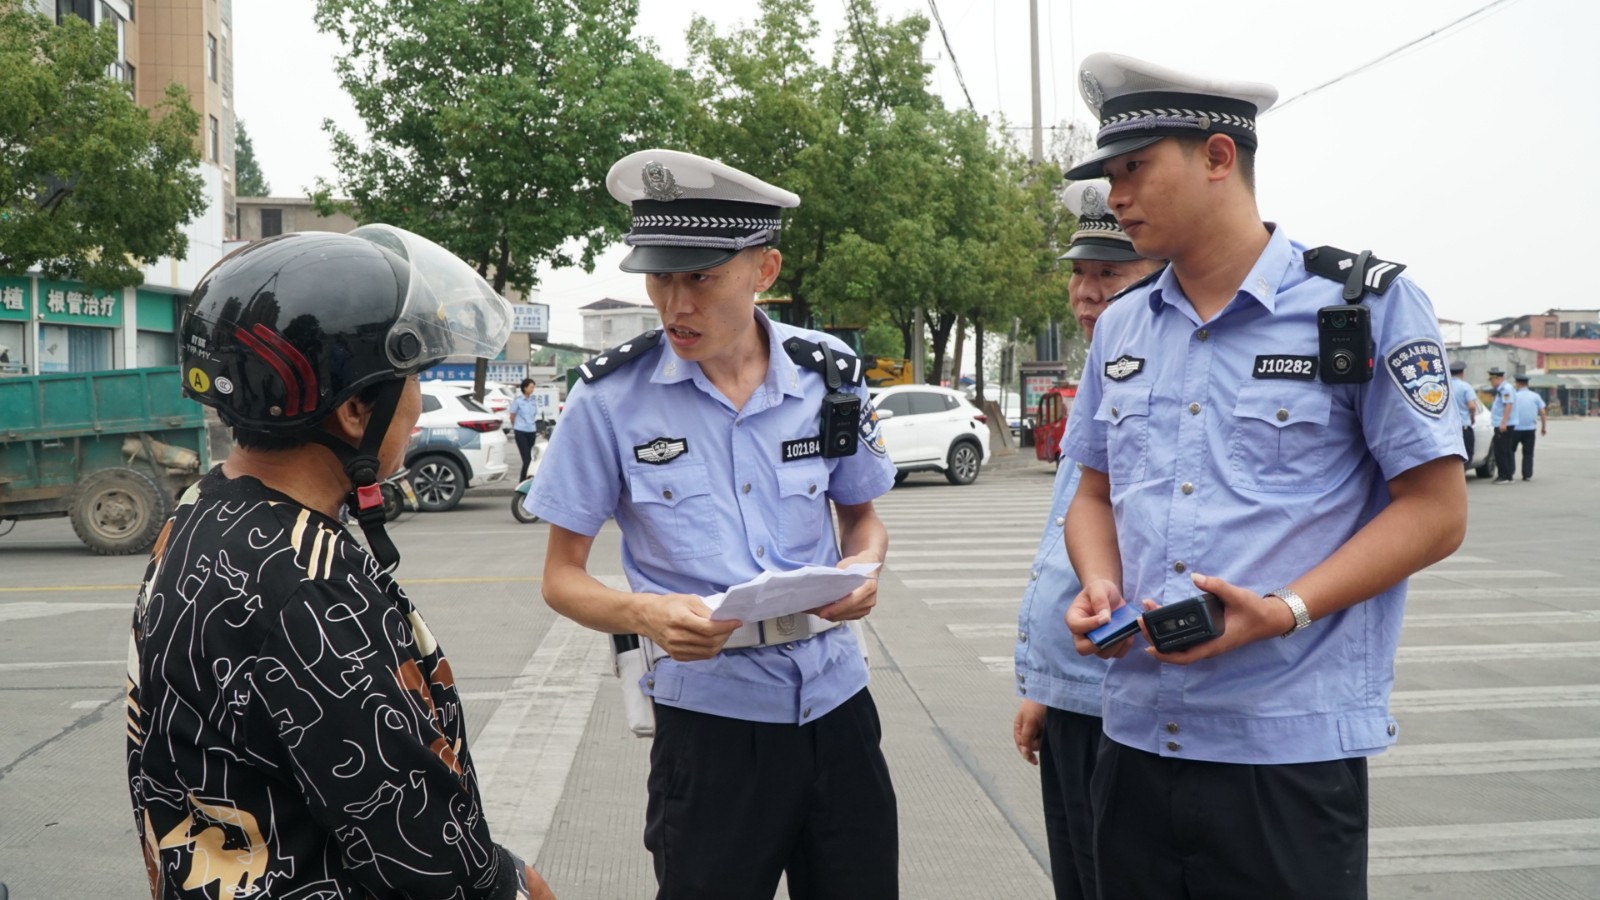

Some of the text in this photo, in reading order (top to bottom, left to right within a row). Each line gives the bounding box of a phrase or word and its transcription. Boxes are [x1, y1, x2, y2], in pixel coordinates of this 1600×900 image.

[0, 286, 25, 311] 植
[47, 290, 116, 317] 根管治疗
[1257, 358, 1313, 375] J10282
[1392, 345, 1440, 368] 中华人民共和国
[194, 372, 203, 389] A
[786, 441, 820, 458] 102184
